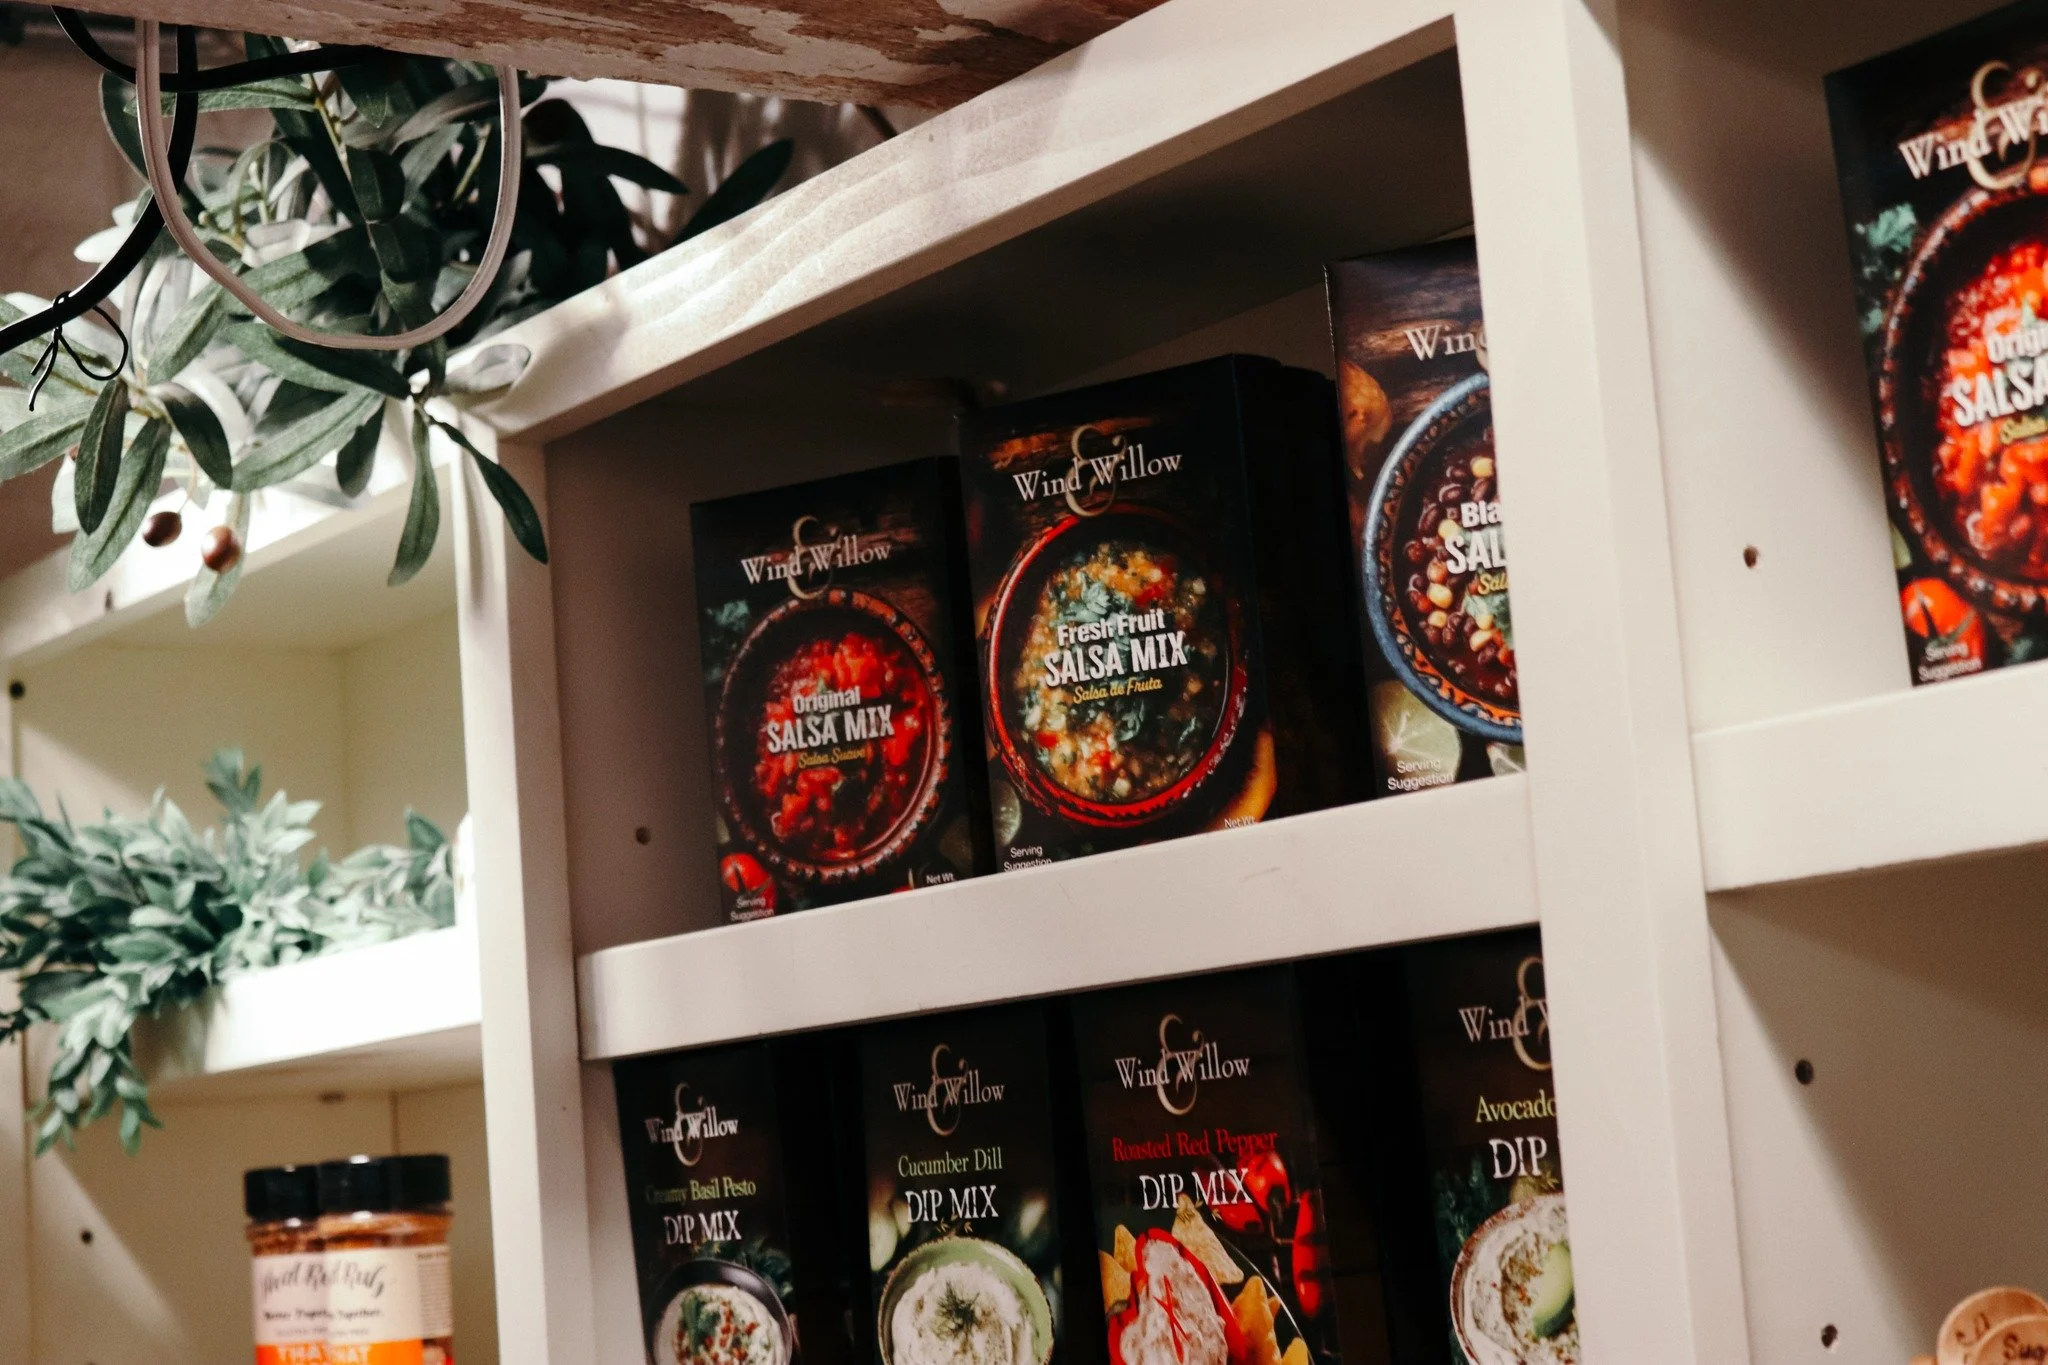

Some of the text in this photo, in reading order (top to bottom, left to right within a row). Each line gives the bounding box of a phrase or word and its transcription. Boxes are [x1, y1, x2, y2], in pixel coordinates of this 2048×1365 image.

[1898, 108, 1992, 179] Wind
[1013, 456, 1083, 502] Wind
[1090, 444, 1183, 486] Willow
[1460, 500, 1502, 528] Bla
[741, 545, 803, 584] Wind
[810, 534, 892, 572] Willow
[1444, 528, 1507, 574] SAL
[1057, 607, 1166, 648] Fresh Fruit
[1043, 629, 1188, 690] SALSA MIX
[793, 685, 861, 715] Original
[1073, 676, 1163, 705] Salsa de Fruta
[766, 704, 895, 753] SALSA MIX
[1387, 773, 1455, 791] Suggestion
[1396, 759, 1441, 774] Serving
[1010, 845, 1043, 859] Serving
[1458, 996, 1530, 1044] Wind
[1115, 1048, 1168, 1090] Wind
[1175, 1041, 1250, 1083] Willow
[892, 1075, 938, 1112] Wind
[943, 1068, 1005, 1105] Willow
[644, 1112, 684, 1144] Wind
[685, 1104, 740, 1139] Willow
[898, 1145, 1004, 1178] Cucumber Dill
[1112, 1127, 1279, 1162] Roasted Red Pepper
[1488, 1135, 1548, 1180] DIP
[690, 1176, 720, 1201] Basil
[722, 1176, 757, 1198] Pesto
[905, 1184, 999, 1224] DIP MIX
[1139, 1167, 1254, 1211] DIP MIX
[663, 1209, 742, 1245] DIP MIX
